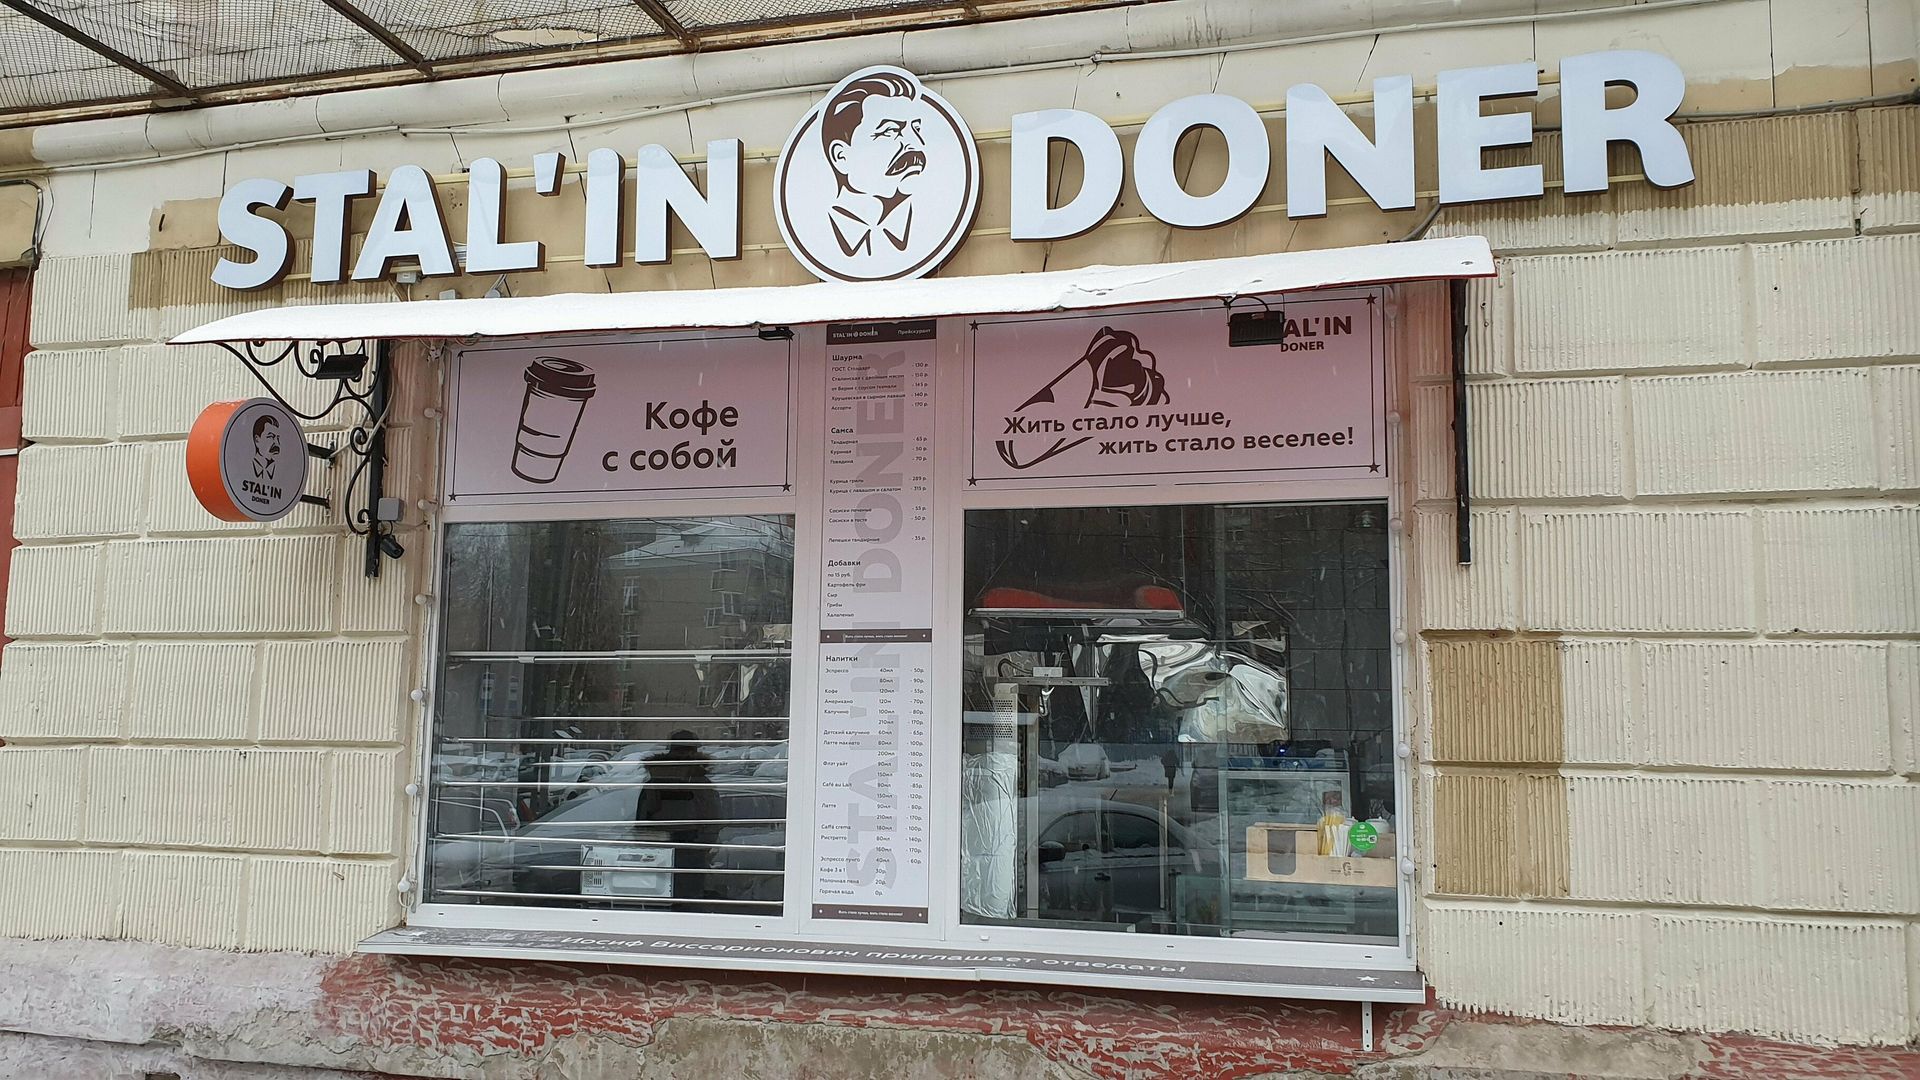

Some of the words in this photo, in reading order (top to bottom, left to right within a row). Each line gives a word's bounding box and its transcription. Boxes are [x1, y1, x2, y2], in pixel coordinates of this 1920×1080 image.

[211, 138, 744, 290] STAL'IN
[1010, 49, 1695, 242] DONER
[1283, 316, 1352, 338] AL'IN
[1280, 341, 1324, 352] DONER
[645, 400, 739, 435] Кофе
[1003, 416, 1065, 435] Жить
[1072, 415, 1139, 432] стало
[1145, 409, 1232, 431] лучше,
[602, 451, 618, 471] с
[629, 438, 737, 471] собой
[1098, 437, 1158, 455] жить
[1165, 436, 1236, 453] стало
[1243, 427, 1354, 450] веселее!
[242, 480, 282, 500] STAL'IN
[251, 495, 270, 505] DONER
[560, 935, 644, 949] Иосиф
[649, 940, 859, 958] Виссарионович
[867, 951, 1036, 964] приглашает
[1042, 958, 1186, 973] отведать!
